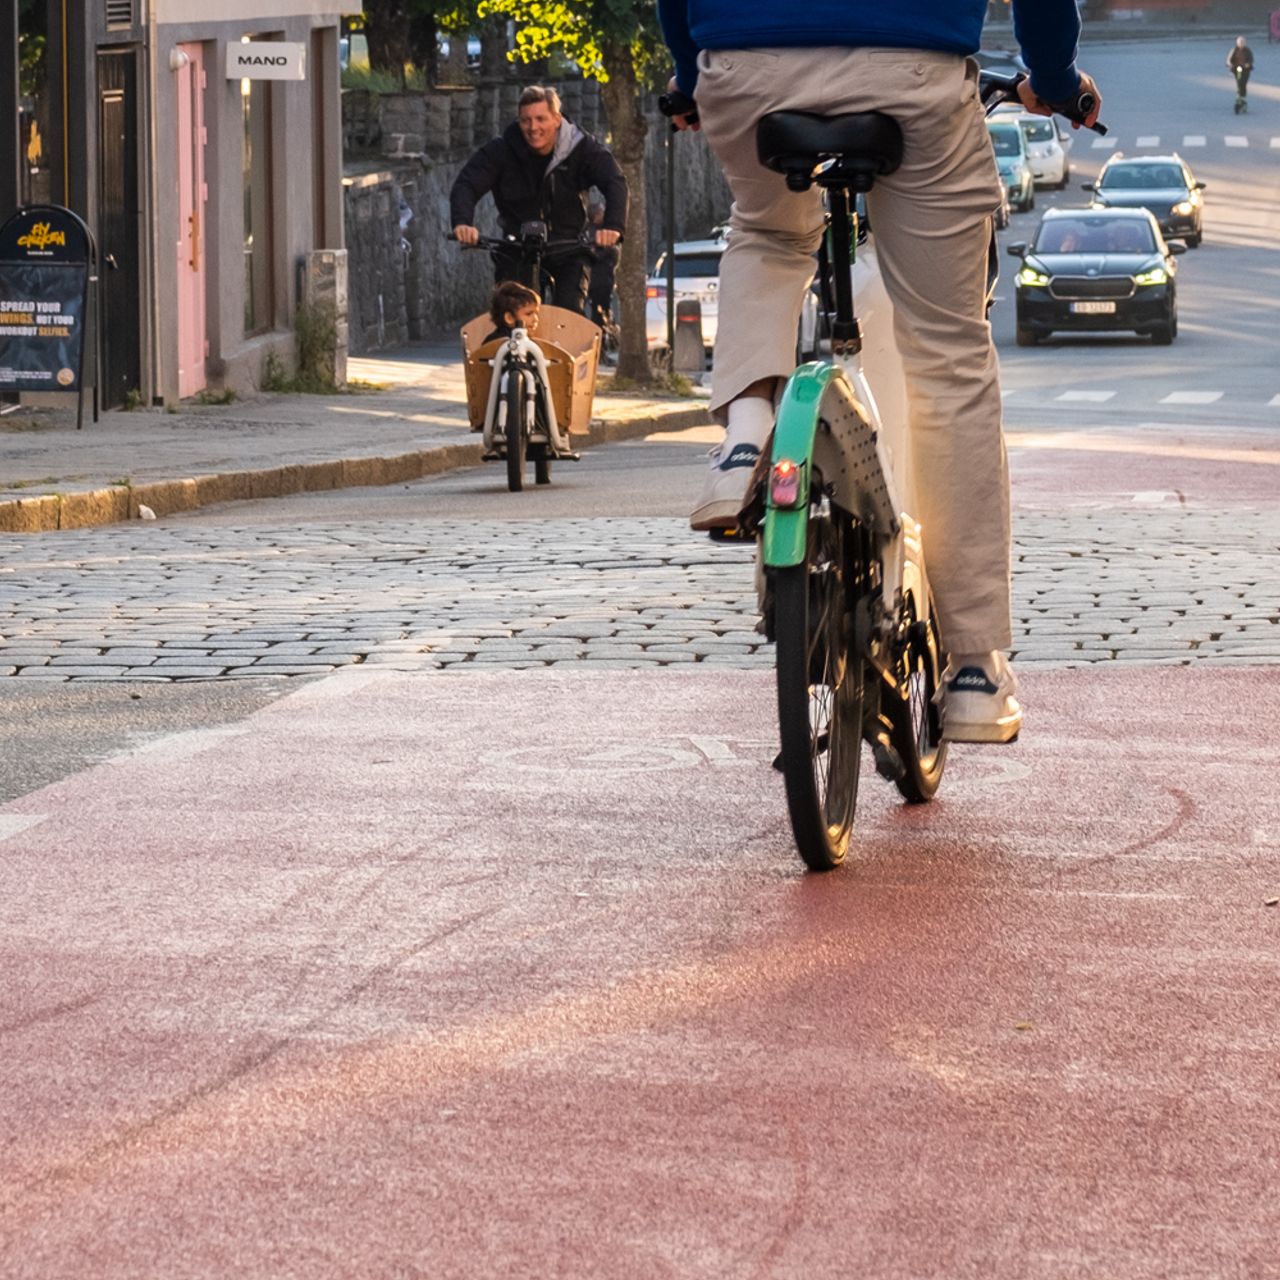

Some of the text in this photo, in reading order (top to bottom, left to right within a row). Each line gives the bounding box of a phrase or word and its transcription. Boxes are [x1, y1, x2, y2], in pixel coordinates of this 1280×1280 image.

[238, 56, 288, 66] MANO
[0, 301, 60, 313] SPREAD YOUR
[36, 315, 51, 324] NOT
[53, 315, 74, 325] YOUR
